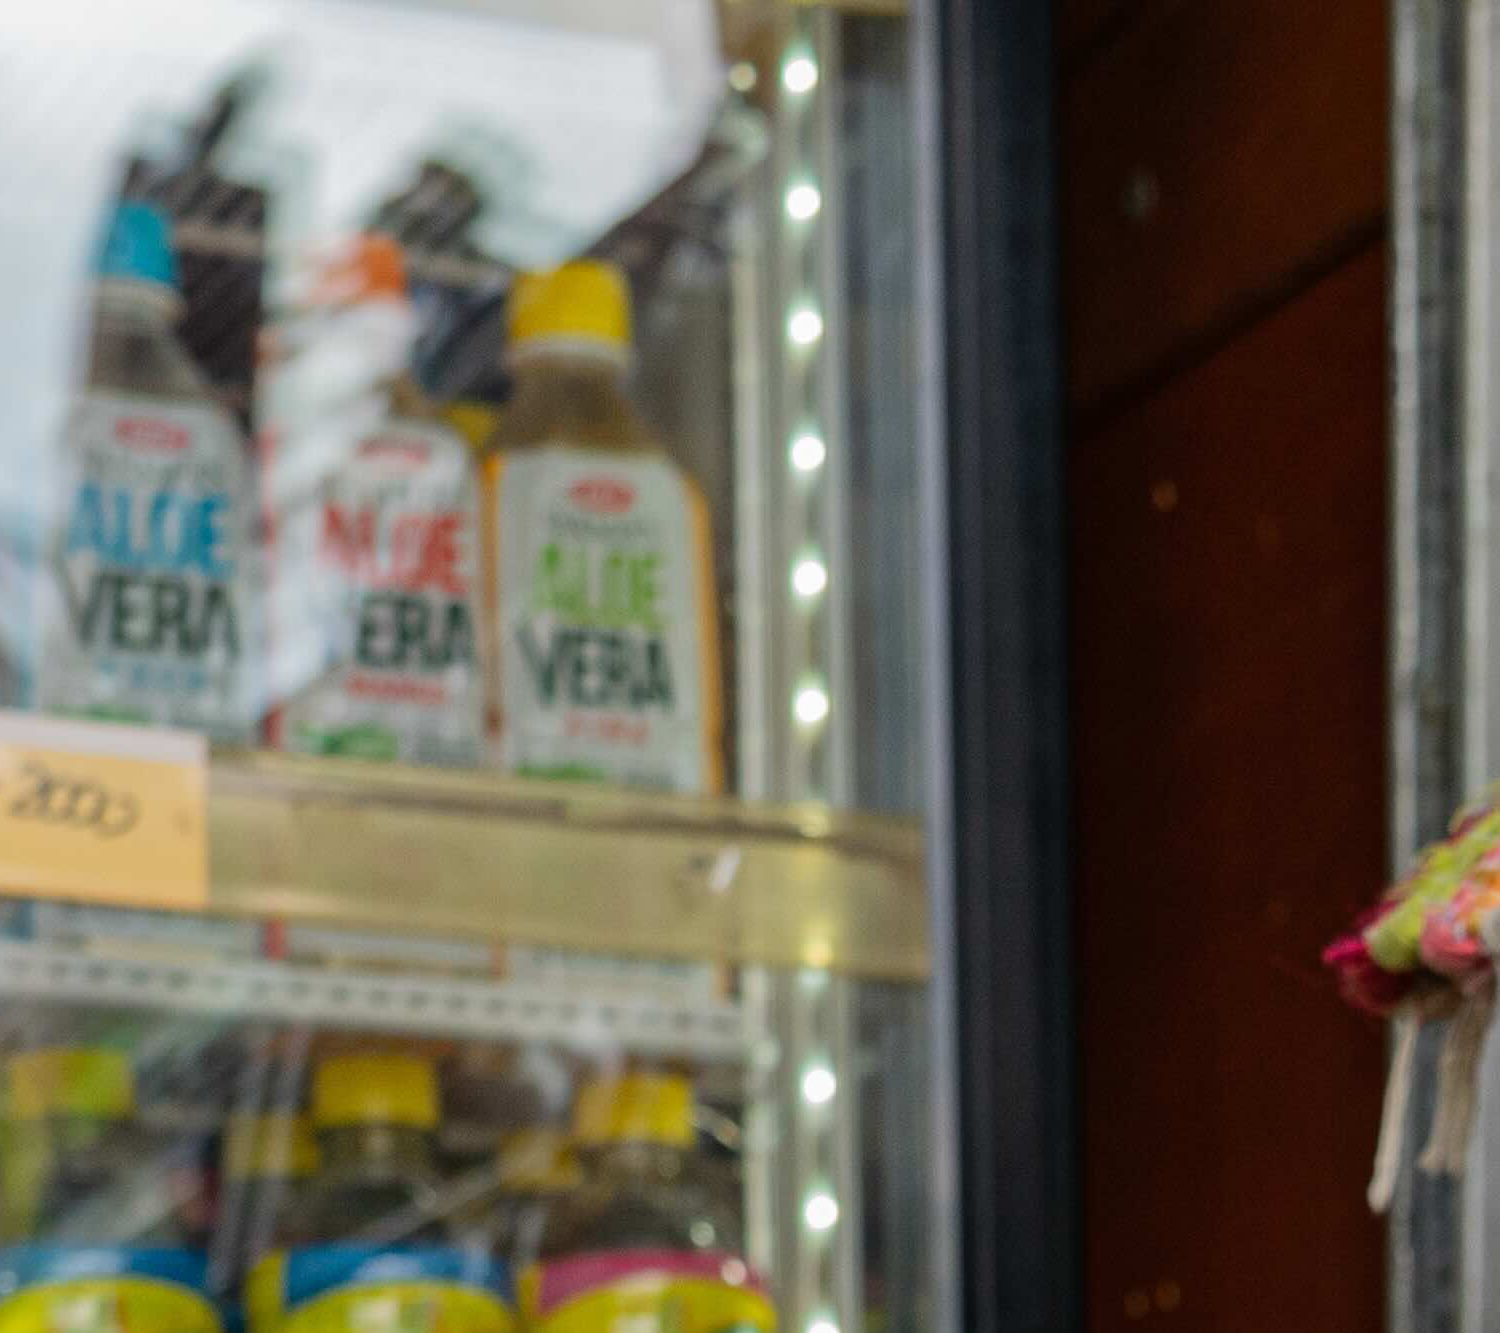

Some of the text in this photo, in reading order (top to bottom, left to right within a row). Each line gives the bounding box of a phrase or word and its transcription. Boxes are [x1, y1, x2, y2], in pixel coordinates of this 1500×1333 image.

[62, 572, 241, 660] VERA
[355, 594, 474, 669] ERA
[517, 622, 674, 708] VERA
